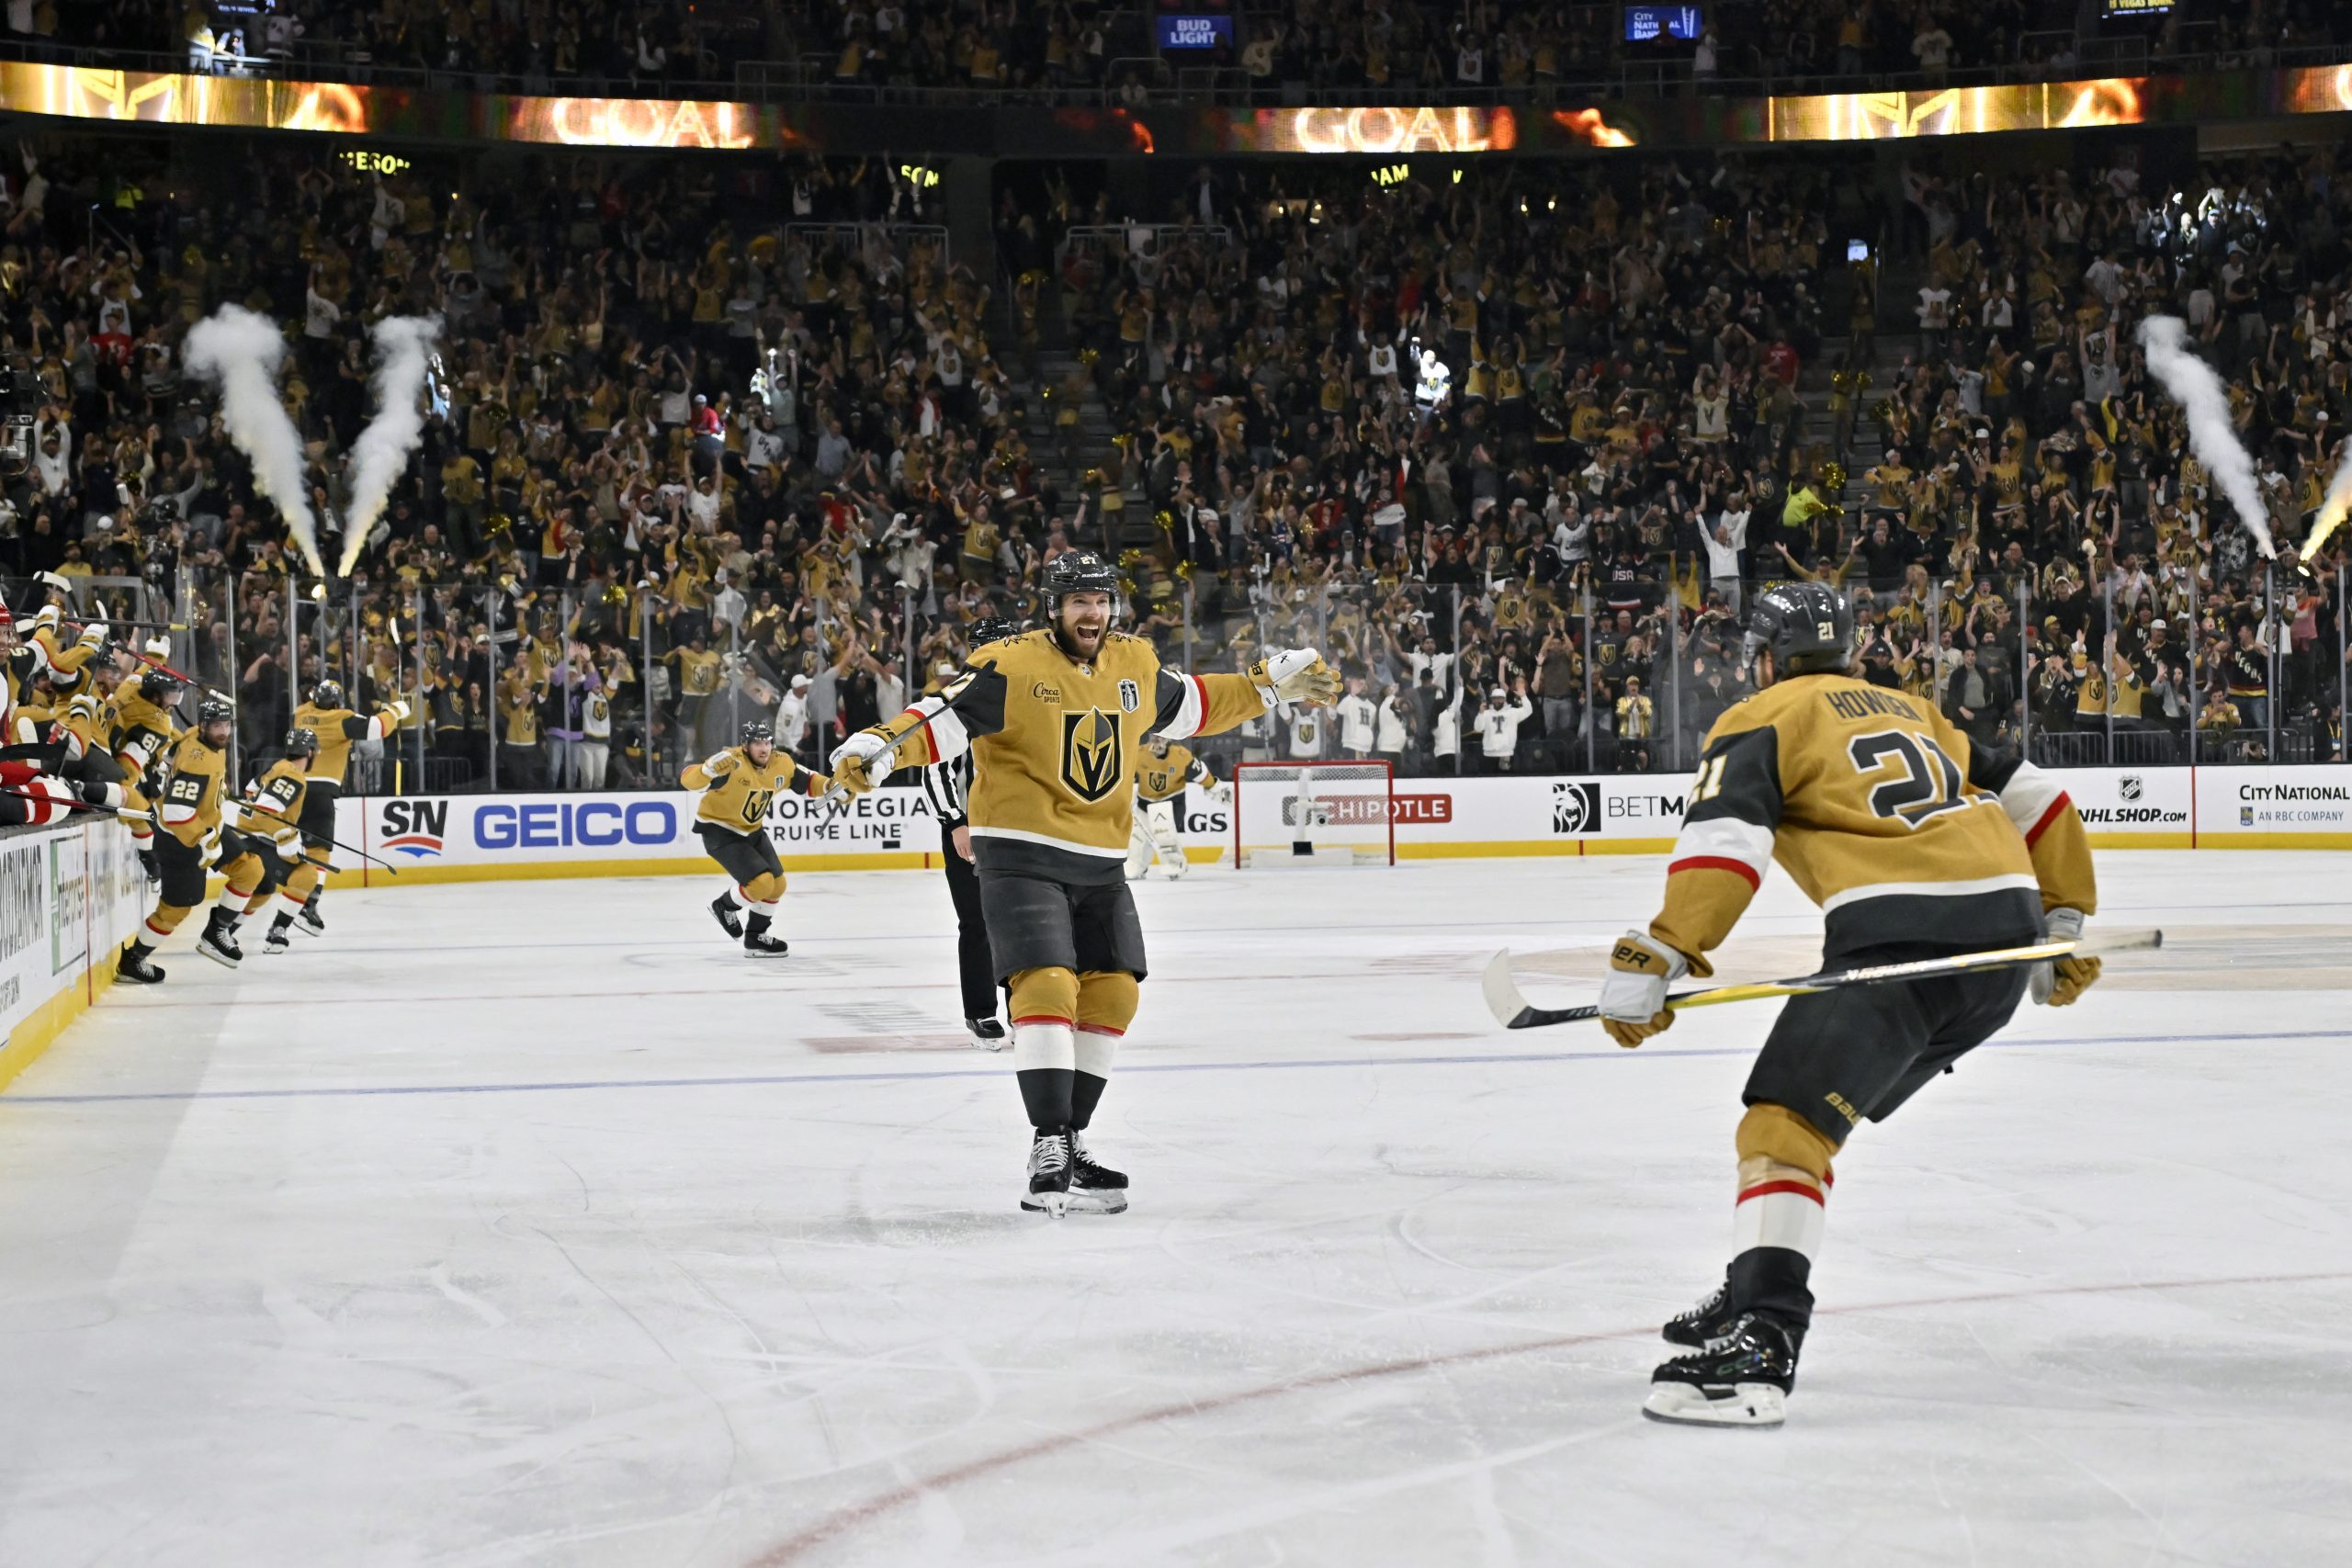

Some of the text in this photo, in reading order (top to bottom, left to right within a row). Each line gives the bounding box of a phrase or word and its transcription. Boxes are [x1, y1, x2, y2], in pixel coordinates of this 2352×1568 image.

[1177, 19, 1212, 31] BUD
[1634, 20, 1680, 29] NATIAL
[1170, 31, 1216, 44] LIGHT
[551, 97, 754, 149] GOAL
[1295, 107, 1489, 152] GOAL
[1080, 556, 1097, 565] 27
[1817, 622, 1836, 640] 21
[1033, 682, 1060, 699] Circa
[1826, 691, 1924, 722] HOWDEN
[141, 732, 162, 754] 61
[171, 779, 200, 801] 22
[271, 778, 296, 800] 52
[1846, 728, 2001, 830] 21
[2239, 784, 2351, 801] CITY NATIONAL
[1608, 795, 1684, 818] BETM
[2258, 810, 2345, 821] AN RBC COMPANY
[380, 800, 448, 838] SN
[473, 801, 677, 849] GEICO
[763, 823, 901, 840] RUISE LINE
